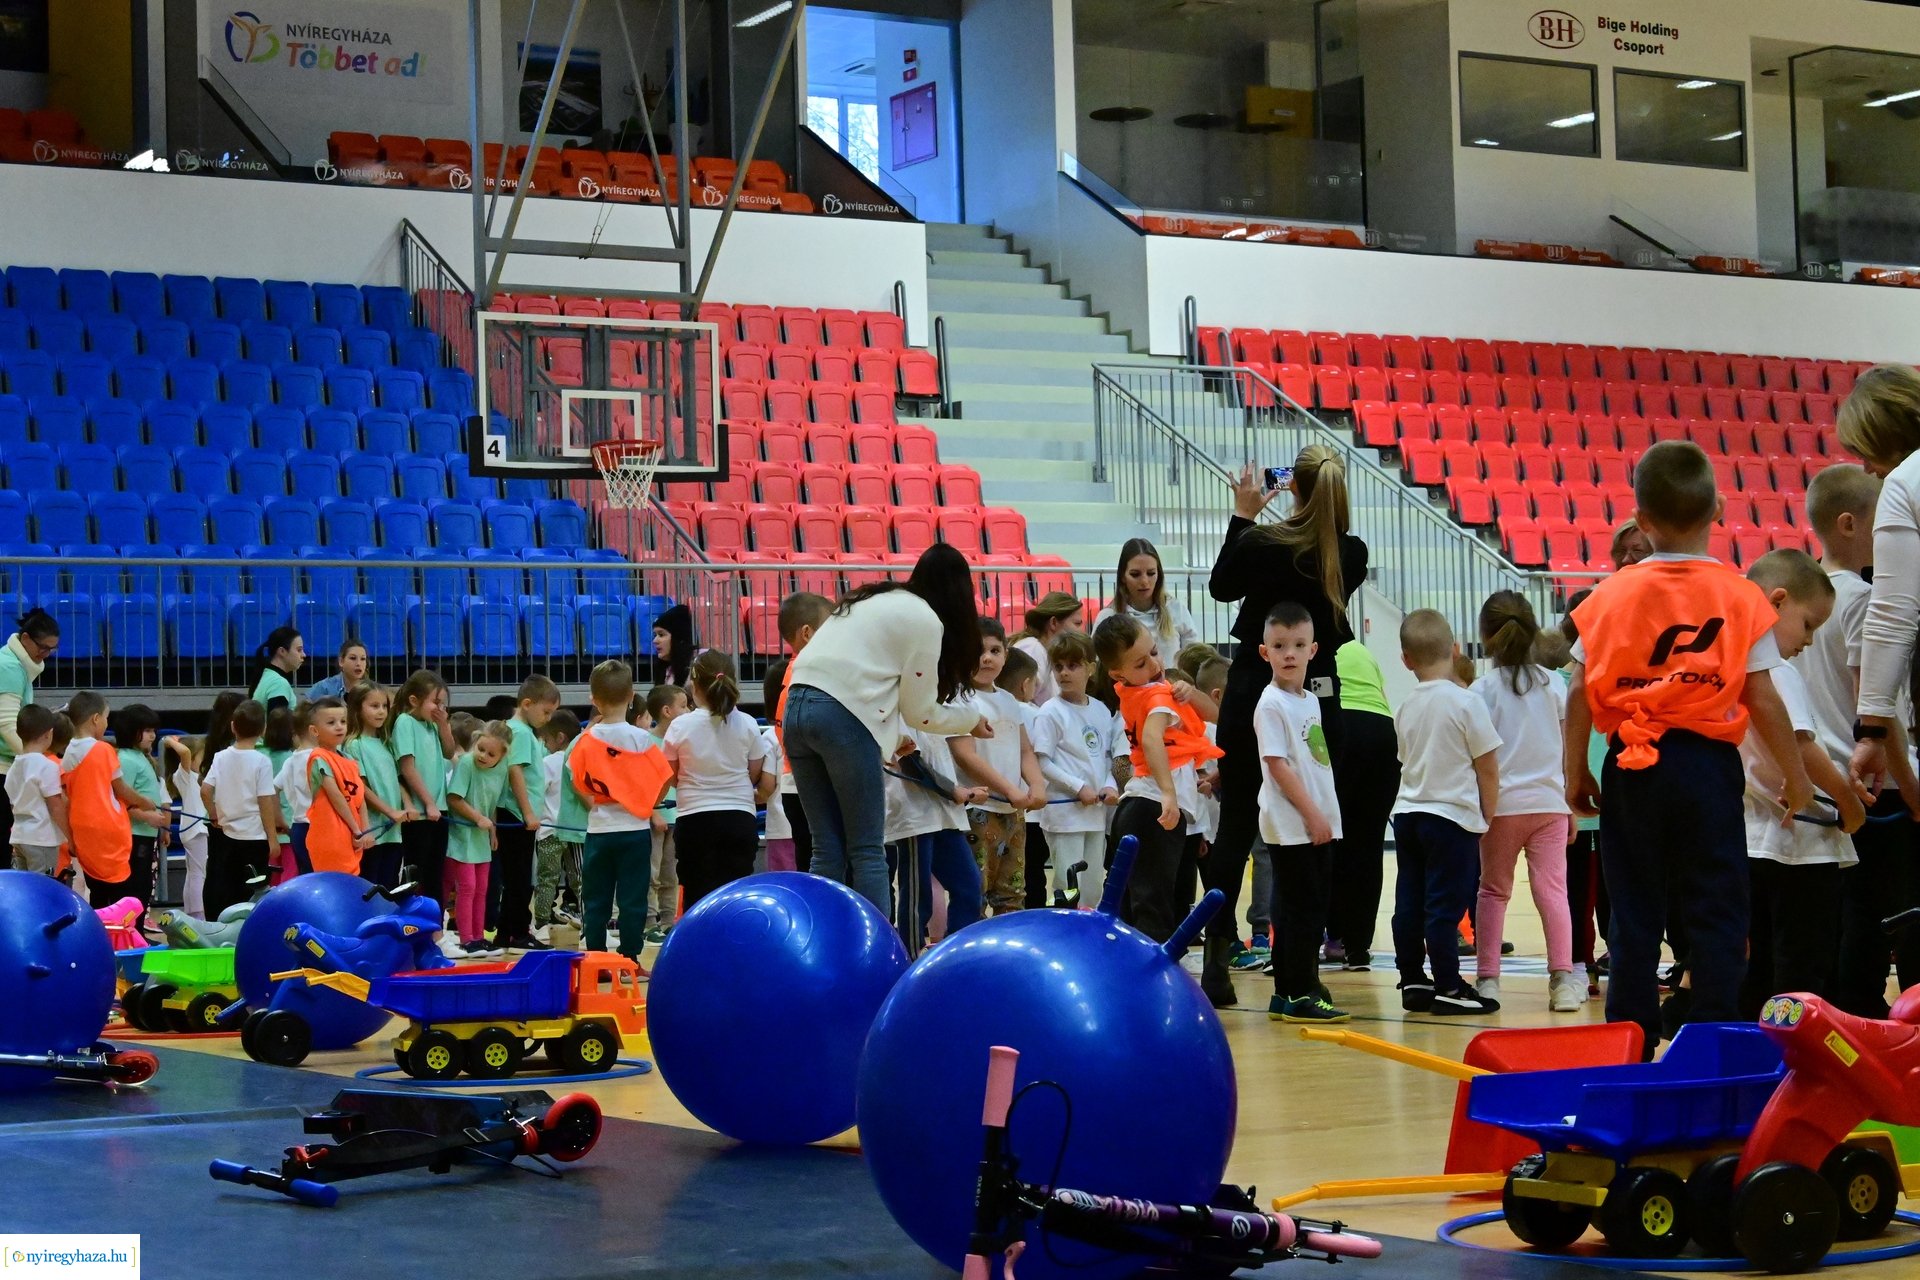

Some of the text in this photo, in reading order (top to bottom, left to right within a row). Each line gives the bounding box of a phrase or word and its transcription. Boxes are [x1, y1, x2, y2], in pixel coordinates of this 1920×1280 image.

[286, 22, 392, 45] NYÍREGYHÁZA
[1539, 16, 1575, 43] BH
[1597, 16, 1679, 39] Bige Holding
[1613, 38, 1665, 55] Csoport
[286, 42, 377, 74] Többet
[601, 184, 661, 198] NYÍREGYHÁZA
[844, 201, 900, 214] NYÍREGYHÁZA
[487, 439, 501, 458] 4
